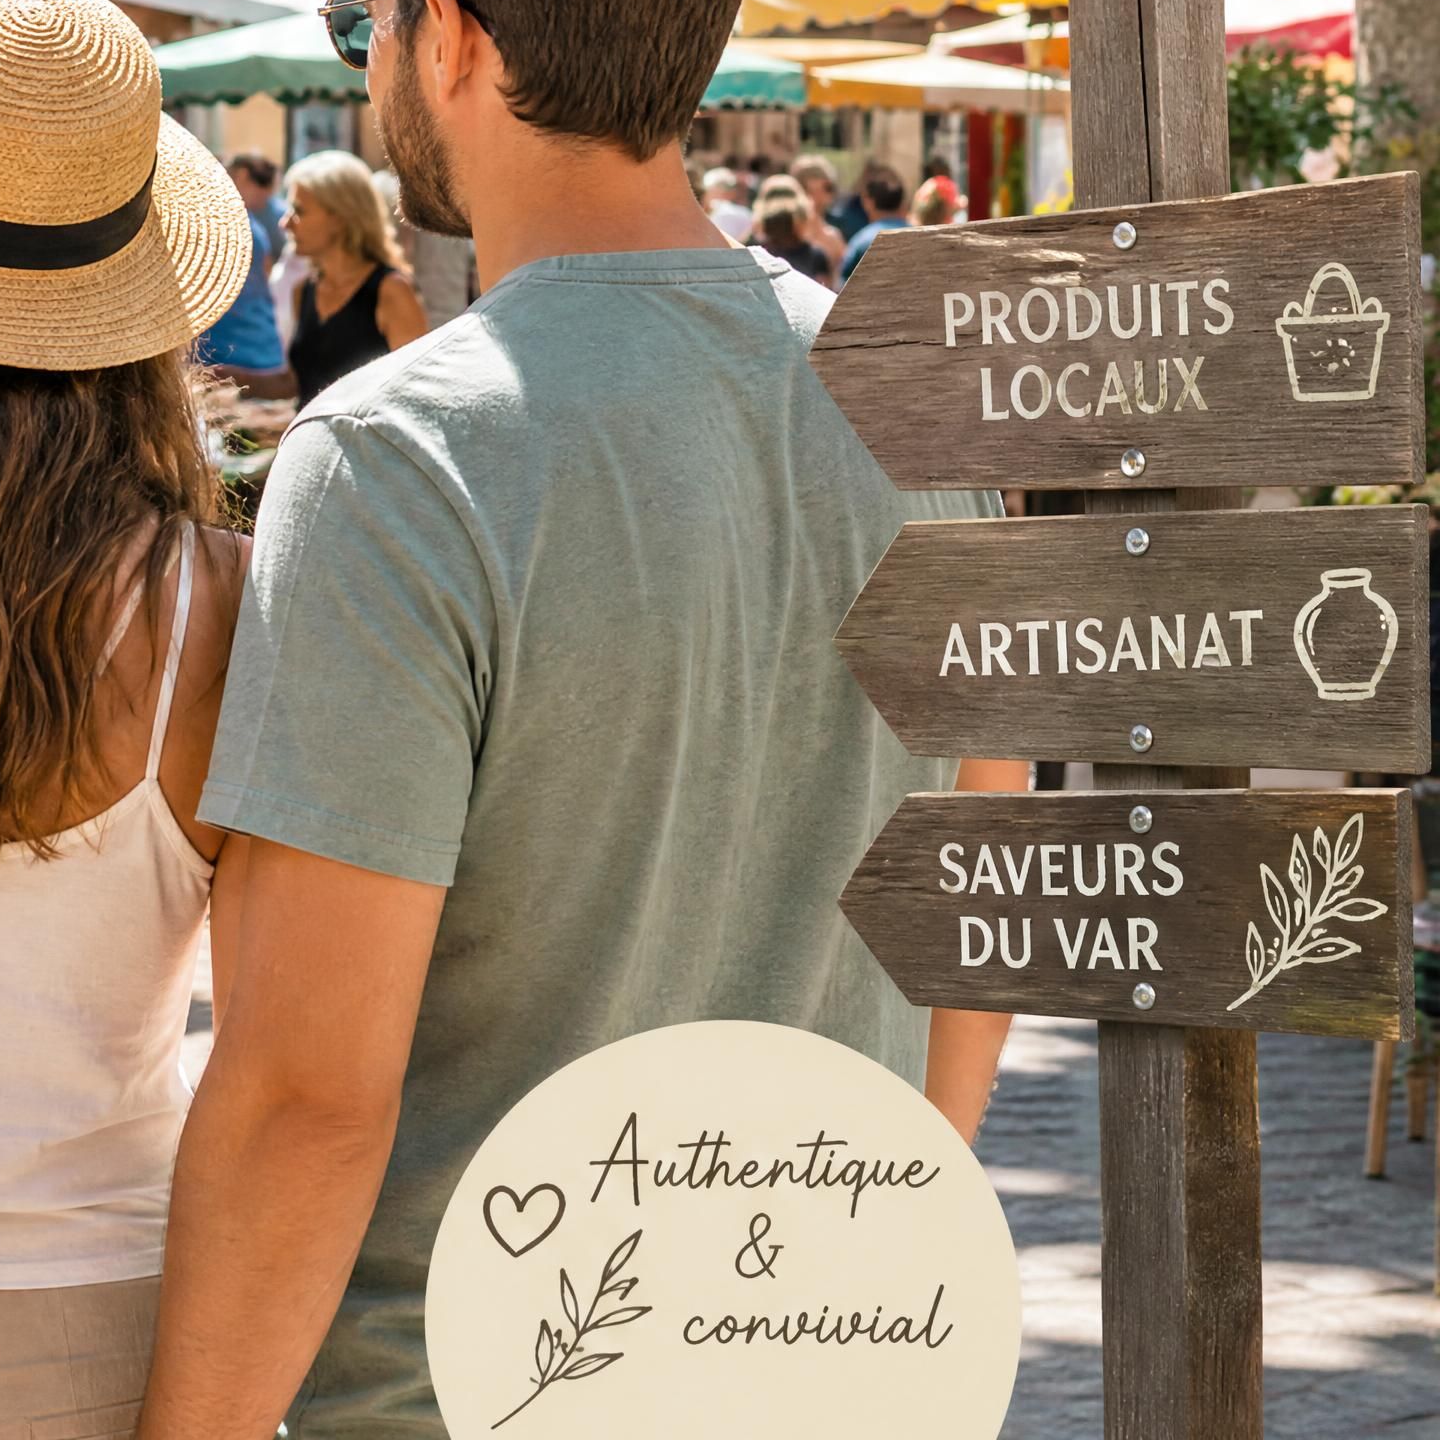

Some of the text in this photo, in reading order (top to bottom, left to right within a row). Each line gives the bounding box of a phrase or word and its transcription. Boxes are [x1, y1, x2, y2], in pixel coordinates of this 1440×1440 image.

[944, 279, 1234, 347] PRODUITS
[981, 356, 1208, 420] LOCAUX
[939, 610, 1263, 676] ARTISANAT
[939, 842, 1183, 896] SAVEURS
[960, 917, 1162, 970] DU VAR
